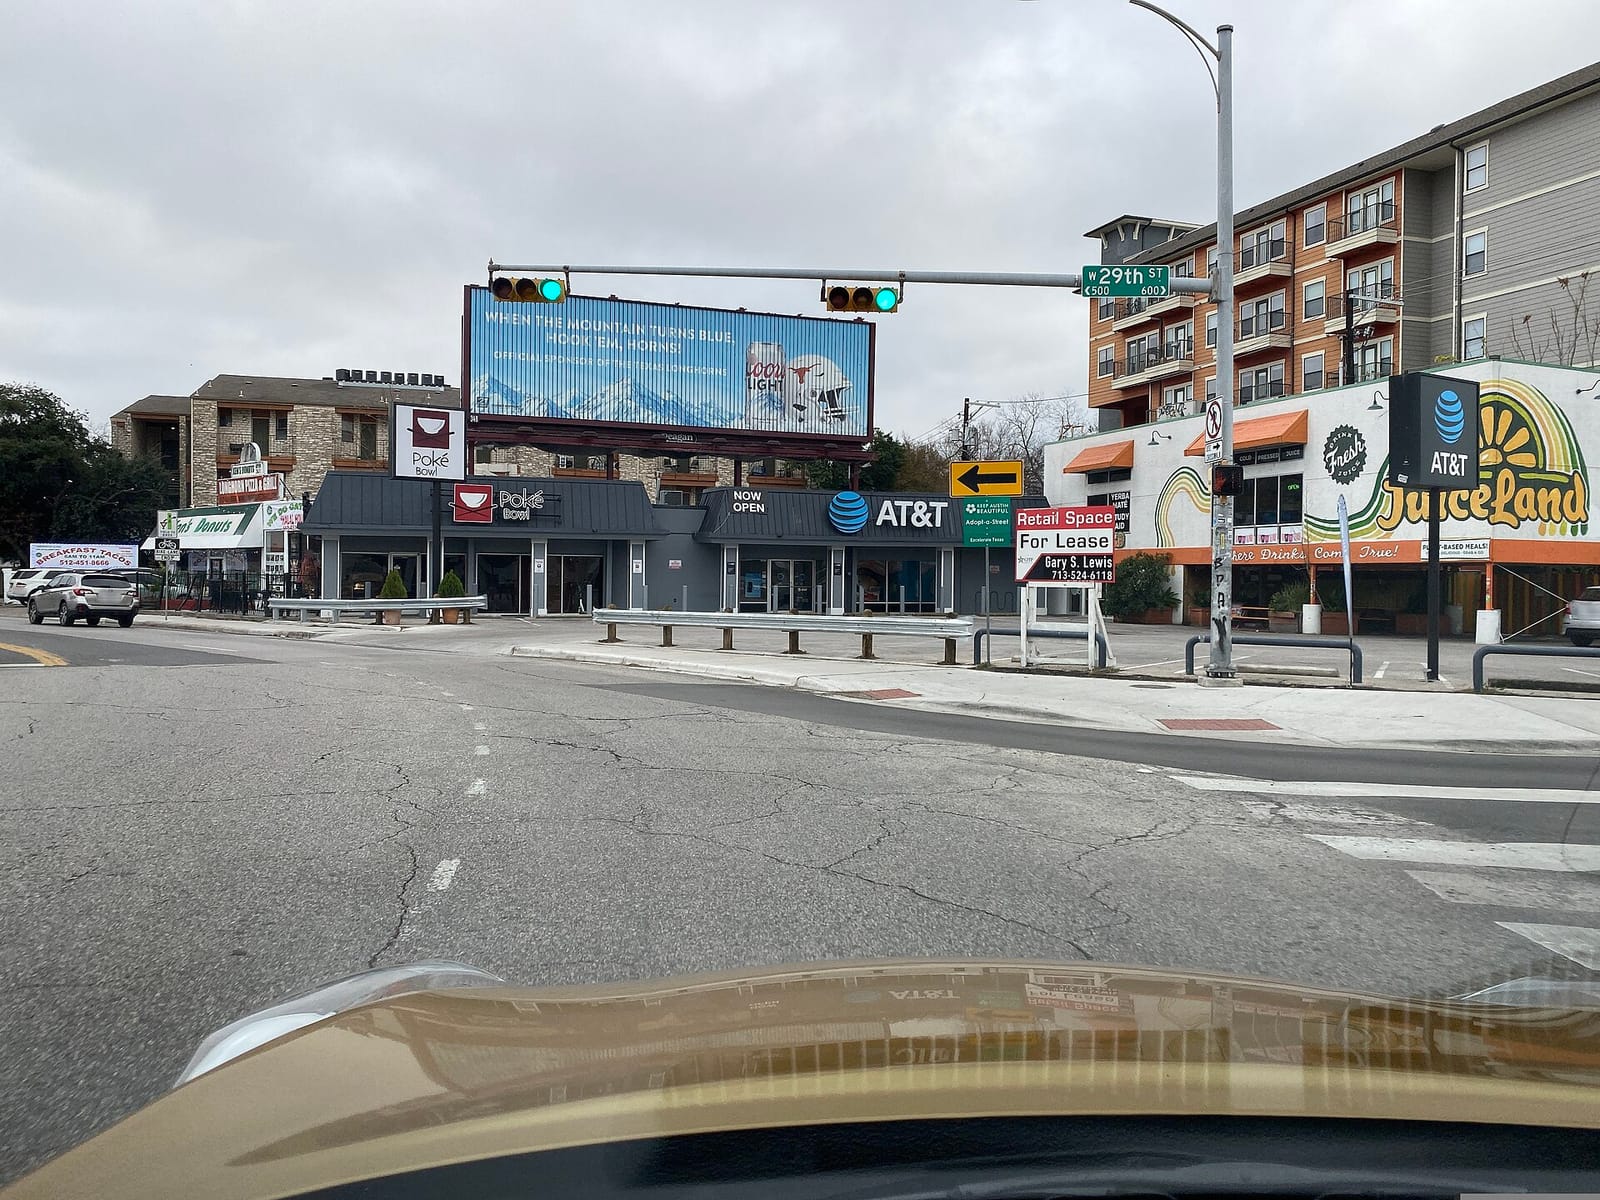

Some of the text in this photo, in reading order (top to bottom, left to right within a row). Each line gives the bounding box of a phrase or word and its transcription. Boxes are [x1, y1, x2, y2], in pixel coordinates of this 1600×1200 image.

[1089, 267, 1163, 284] W 29th ST
[1091, 286, 1110, 295] 500
[1141, 286, 1159, 295] 600
[485, 312, 735, 346] WHEN THE MOUNTAIN TURNS BLUE,
[546, 333, 591, 347] HOOK
[627, 339, 681, 354] HORNS!
[494, 351, 542, 363] OFFICIAL
[544, 355, 593, 366] SPONSOR
[597, 358, 610, 367] OF
[614, 360, 631, 369] THE
[666, 365, 727, 377] LONGHORNS
[747, 378, 784, 392] LIGHT
[412, 450, 450, 468] Poké
[1258, 452, 1279, 461] PRESSED
[1286, 449, 1300, 457] JUICE
[1325, 433, 1366, 476] Fresh
[415, 467, 438, 477] Bowl
[1337, 459, 1360, 477] JUICE
[1430, 451, 1468, 477] AT&T
[500, 488, 545, 508] Poké
[733, 491, 762, 501] NOW
[1111, 492, 1130, 501] YERBA
[503, 508, 530, 521] Bowl
[732, 503, 765, 513] OPEN
[876, 500, 949, 528] AT&T
[194, 517, 233, 533] Donuts
[965, 518, 1009, 526] Adopt-a-Street
[1017, 511, 1113, 528] Retail Space
[1114, 513, 1130, 521] TUDY
[1115, 522, 1125, 530] AID
[1021, 533, 1109, 549] For Lease
[36, 547, 97, 566] BREAKFAST
[100, 550, 132, 566] TACOS
[1232, 545, 1399, 561] here Drinks Com True!
[1045, 556, 1067, 571] Gary
[1070, 555, 1080, 568] S.
[1083, 555, 1113, 568] Lewis
[1051, 570, 1113, 580] 713-524-6118
